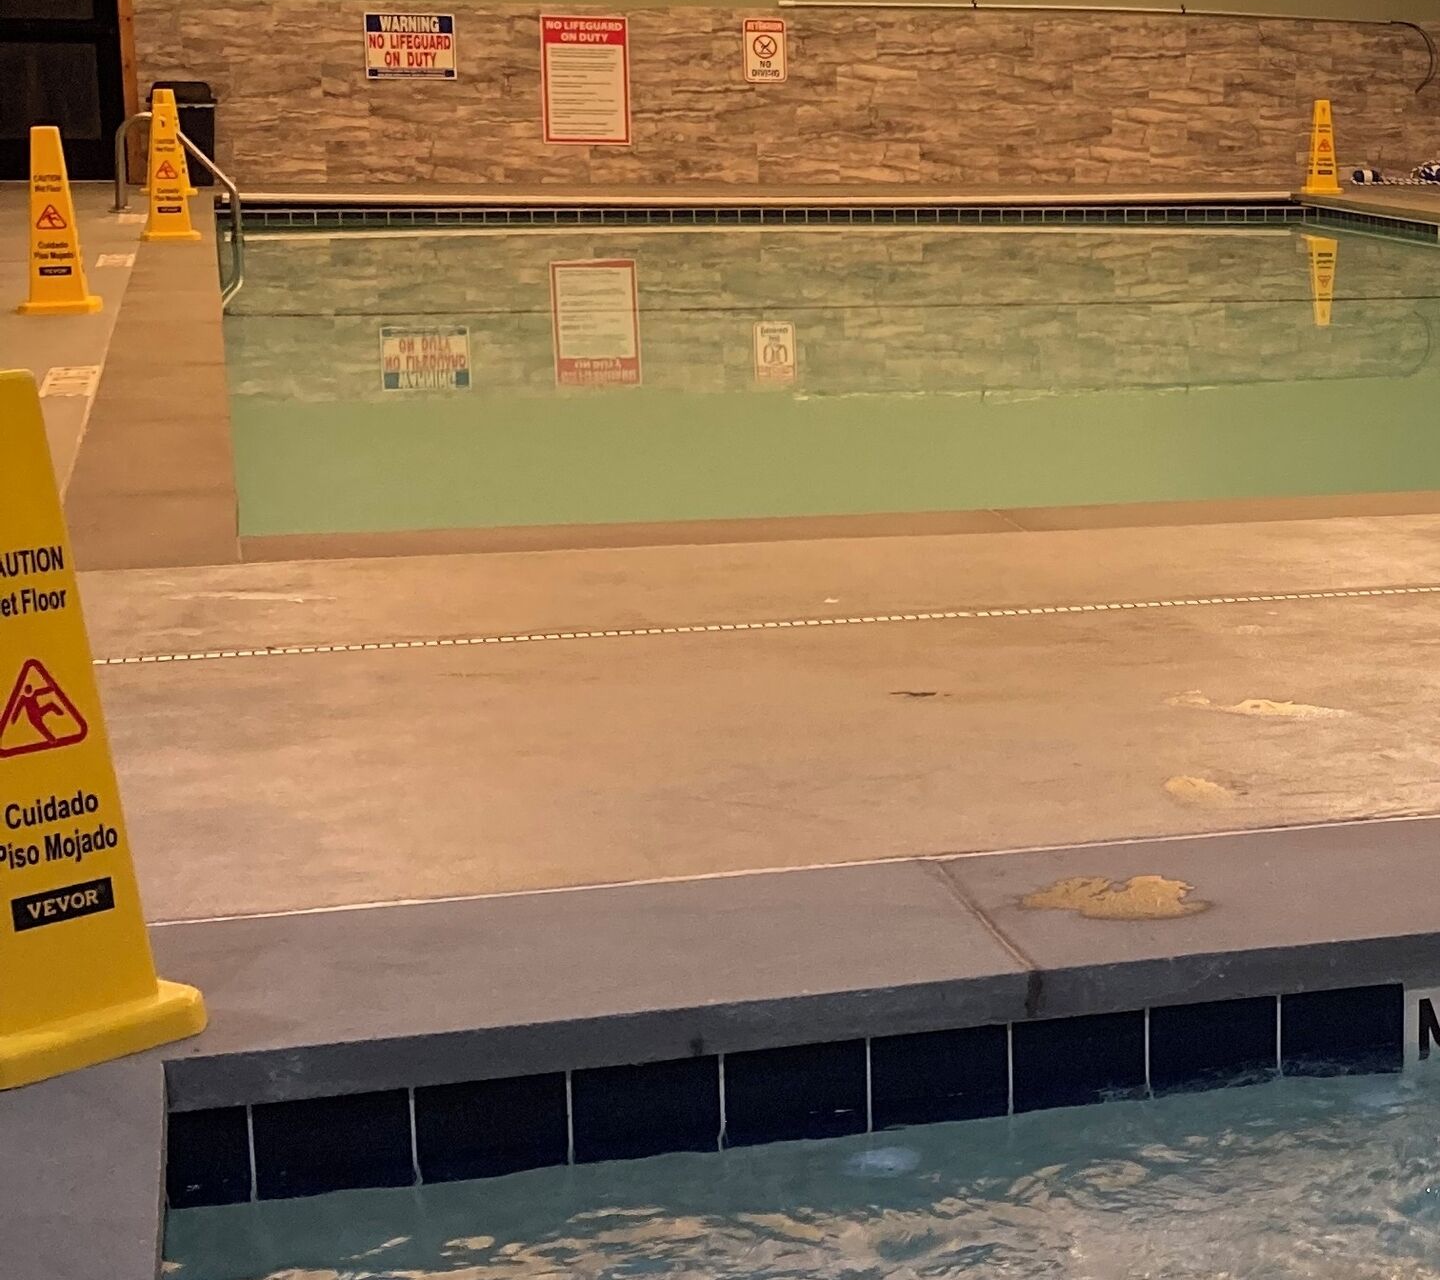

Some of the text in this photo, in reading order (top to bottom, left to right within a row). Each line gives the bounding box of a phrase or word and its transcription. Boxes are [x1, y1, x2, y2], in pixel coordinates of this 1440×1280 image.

[379, 15, 440, 33] WARNING
[545, 21, 623, 31] NO LIFEGUARD
[368, 34, 451, 50] NO LIFEGUARD
[560, 32, 609, 43] ON DUTY
[384, 51, 437, 67] ON DUTY
[759, 60, 772, 68] NO
[751, 69, 780, 78] DIVING
[0, 546, 64, 578] UTION
[0, 588, 66, 617] et Floor
[5, 789, 99, 830] Cuidado
[44, 823, 118, 863] Mojado
[26, 888, 99, 920] VEVOR
